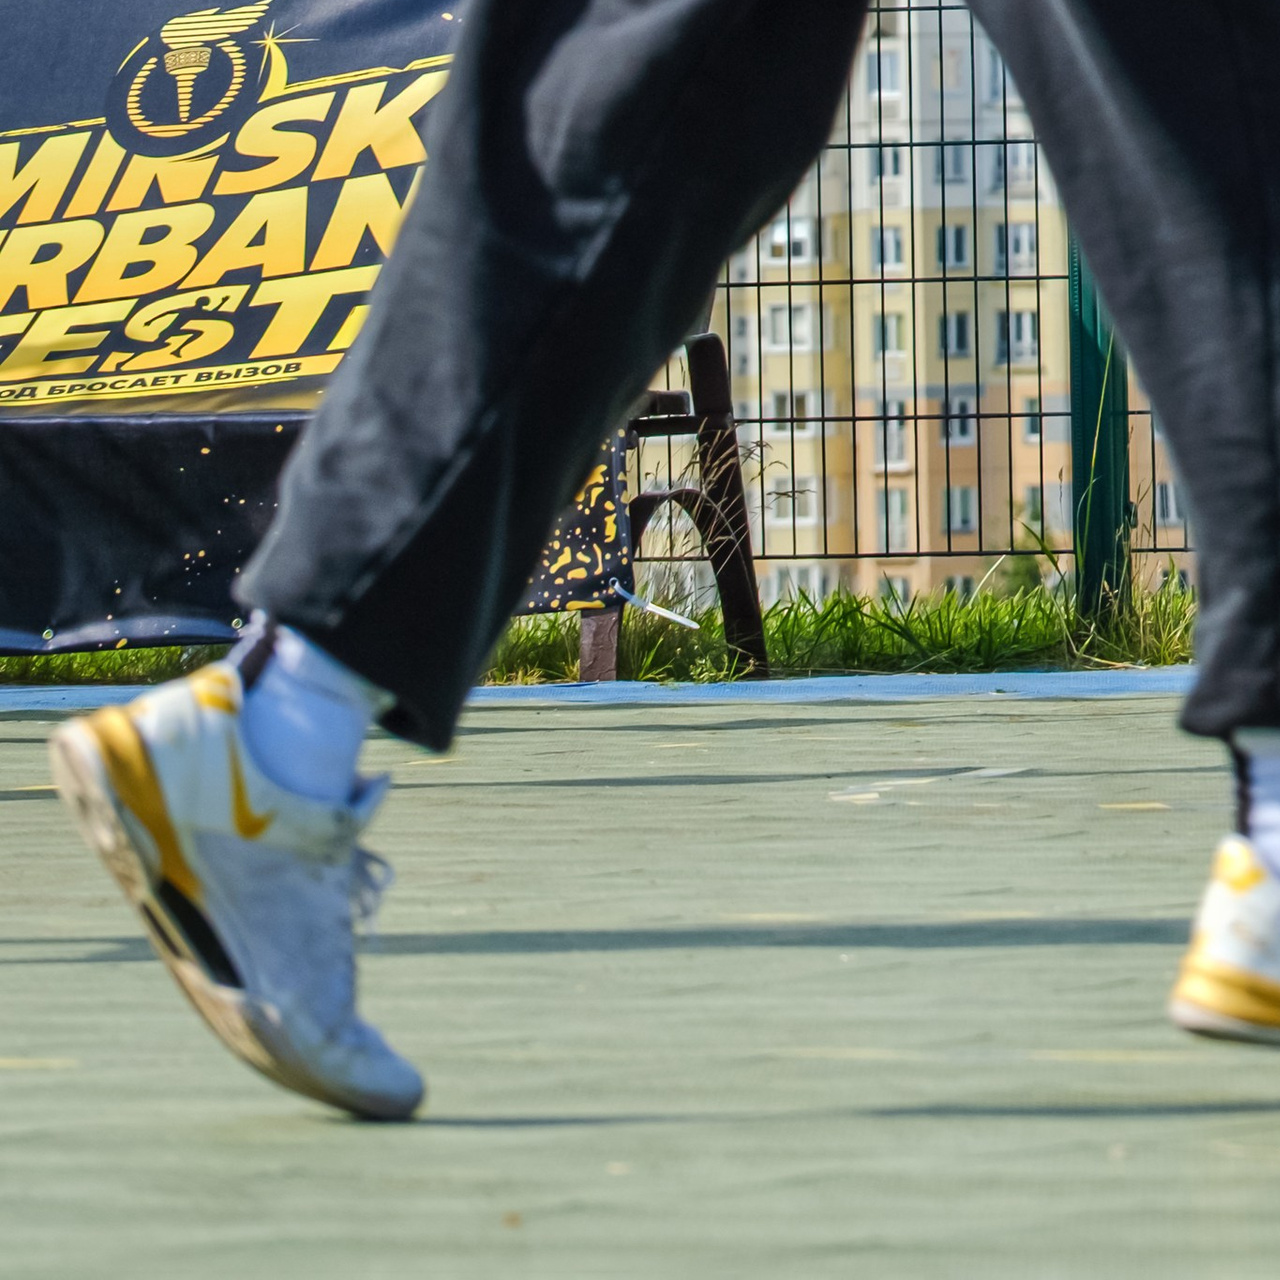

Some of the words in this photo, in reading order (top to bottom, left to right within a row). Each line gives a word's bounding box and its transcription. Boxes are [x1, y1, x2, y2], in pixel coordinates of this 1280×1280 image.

[0, 70, 450, 225] MINSK
[0, 165, 424, 313] RBAN
[47, 374, 188, 396] БРОСАЕТ
[195, 362, 302, 383] ВЫЗОВ
